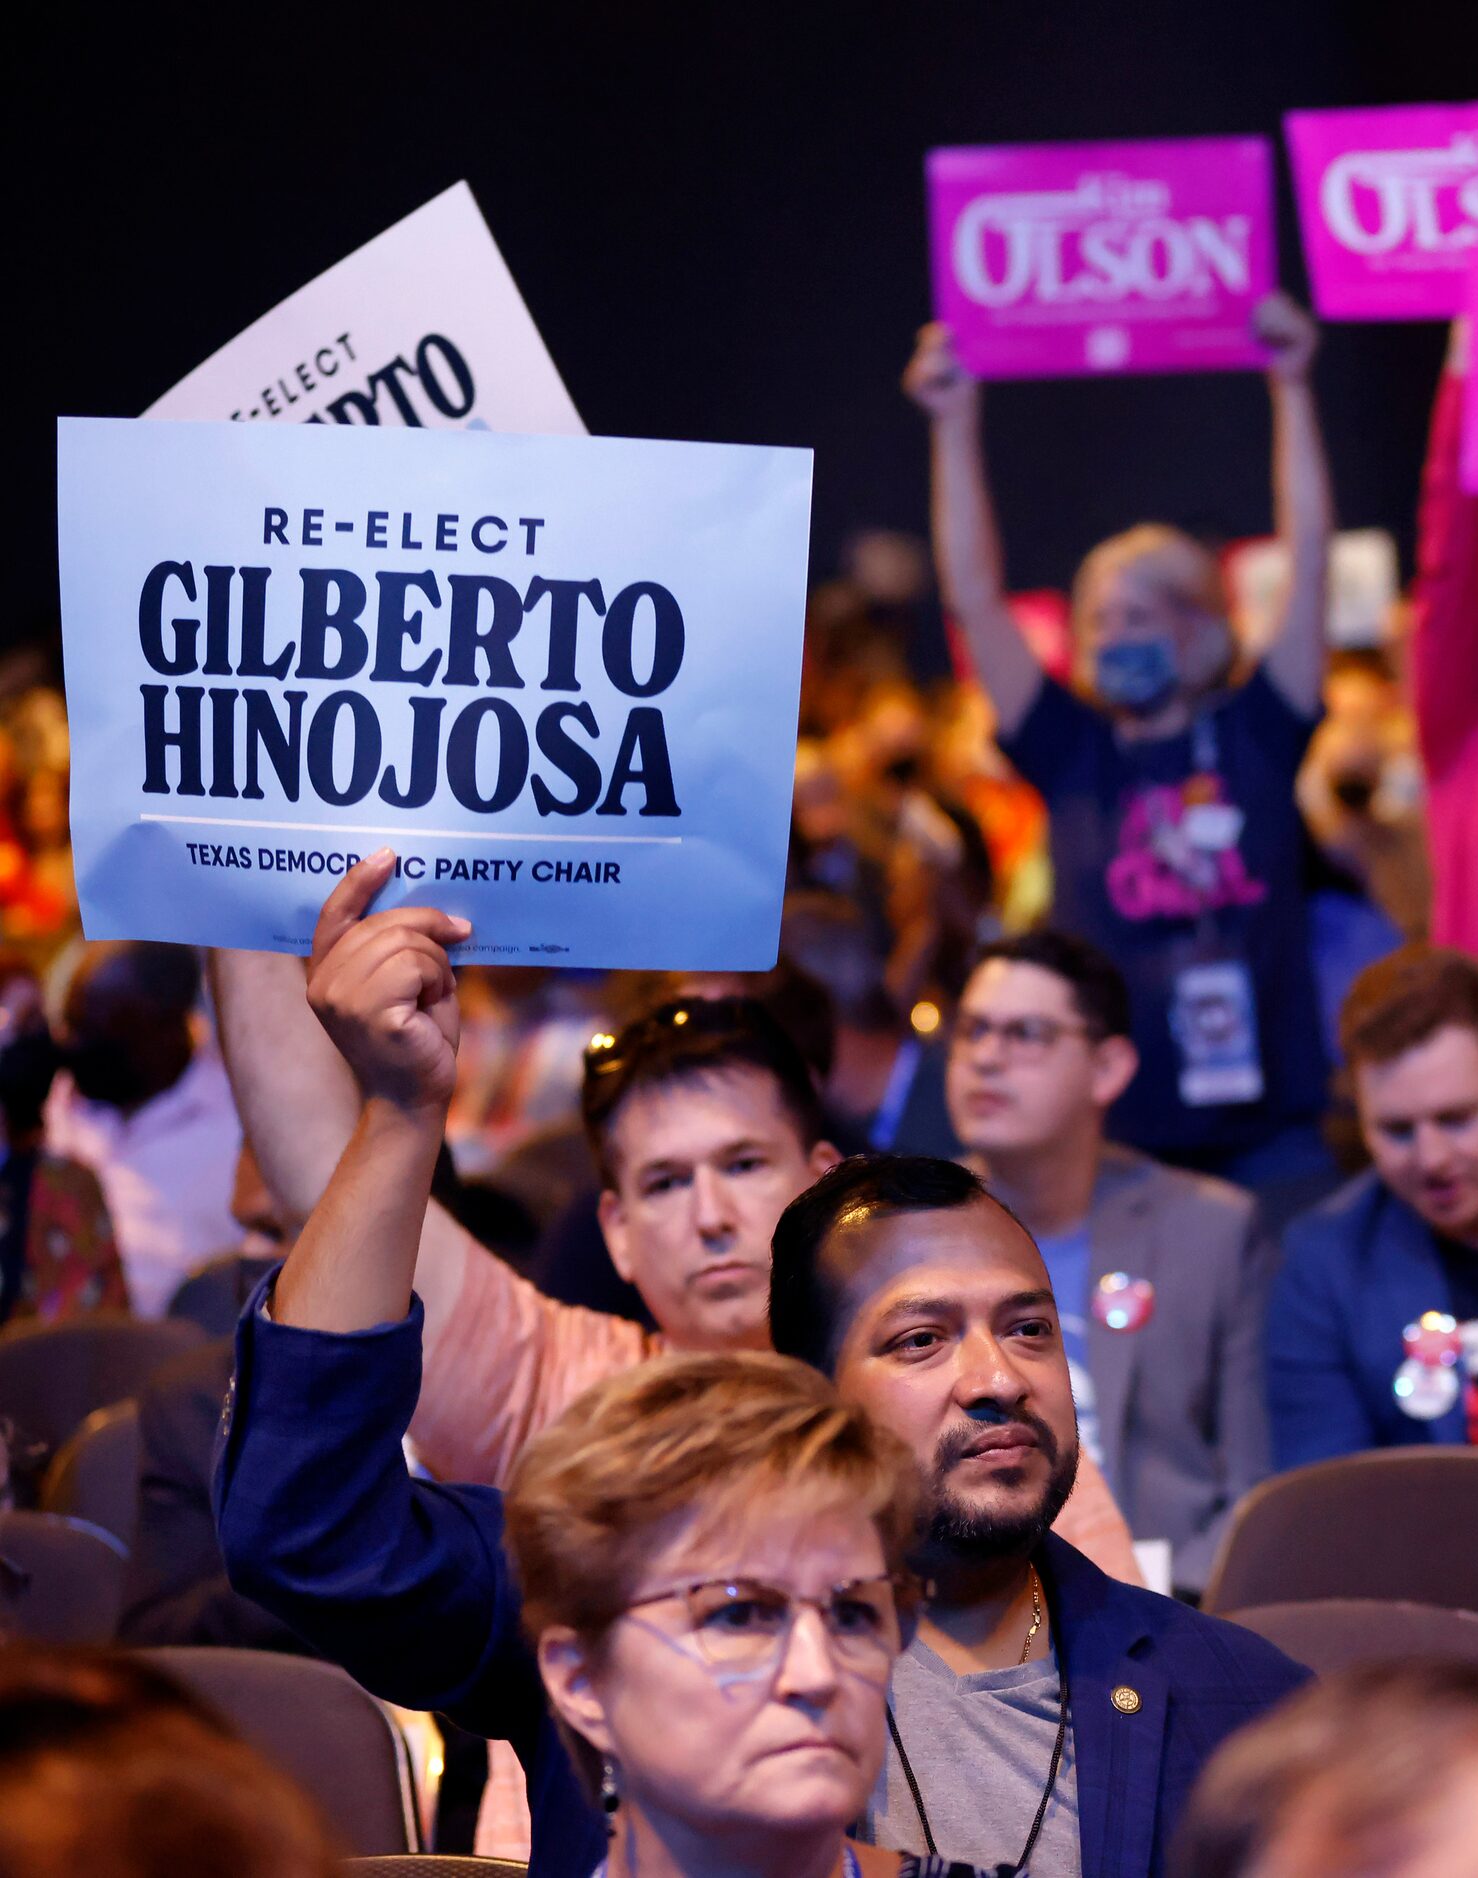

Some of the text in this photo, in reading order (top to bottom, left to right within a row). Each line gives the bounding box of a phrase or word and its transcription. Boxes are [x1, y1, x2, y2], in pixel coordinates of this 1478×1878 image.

[955, 192, 1249, 308] OLSON
[263, 507, 546, 556] RE-ELECT
[138, 560, 685, 698] GILBERTO
[140, 683, 682, 819] HINOJOSA
[186, 843, 252, 870] TEXAS
[434, 857, 523, 882] PARTY
[531, 860, 622, 884] CHAIR
